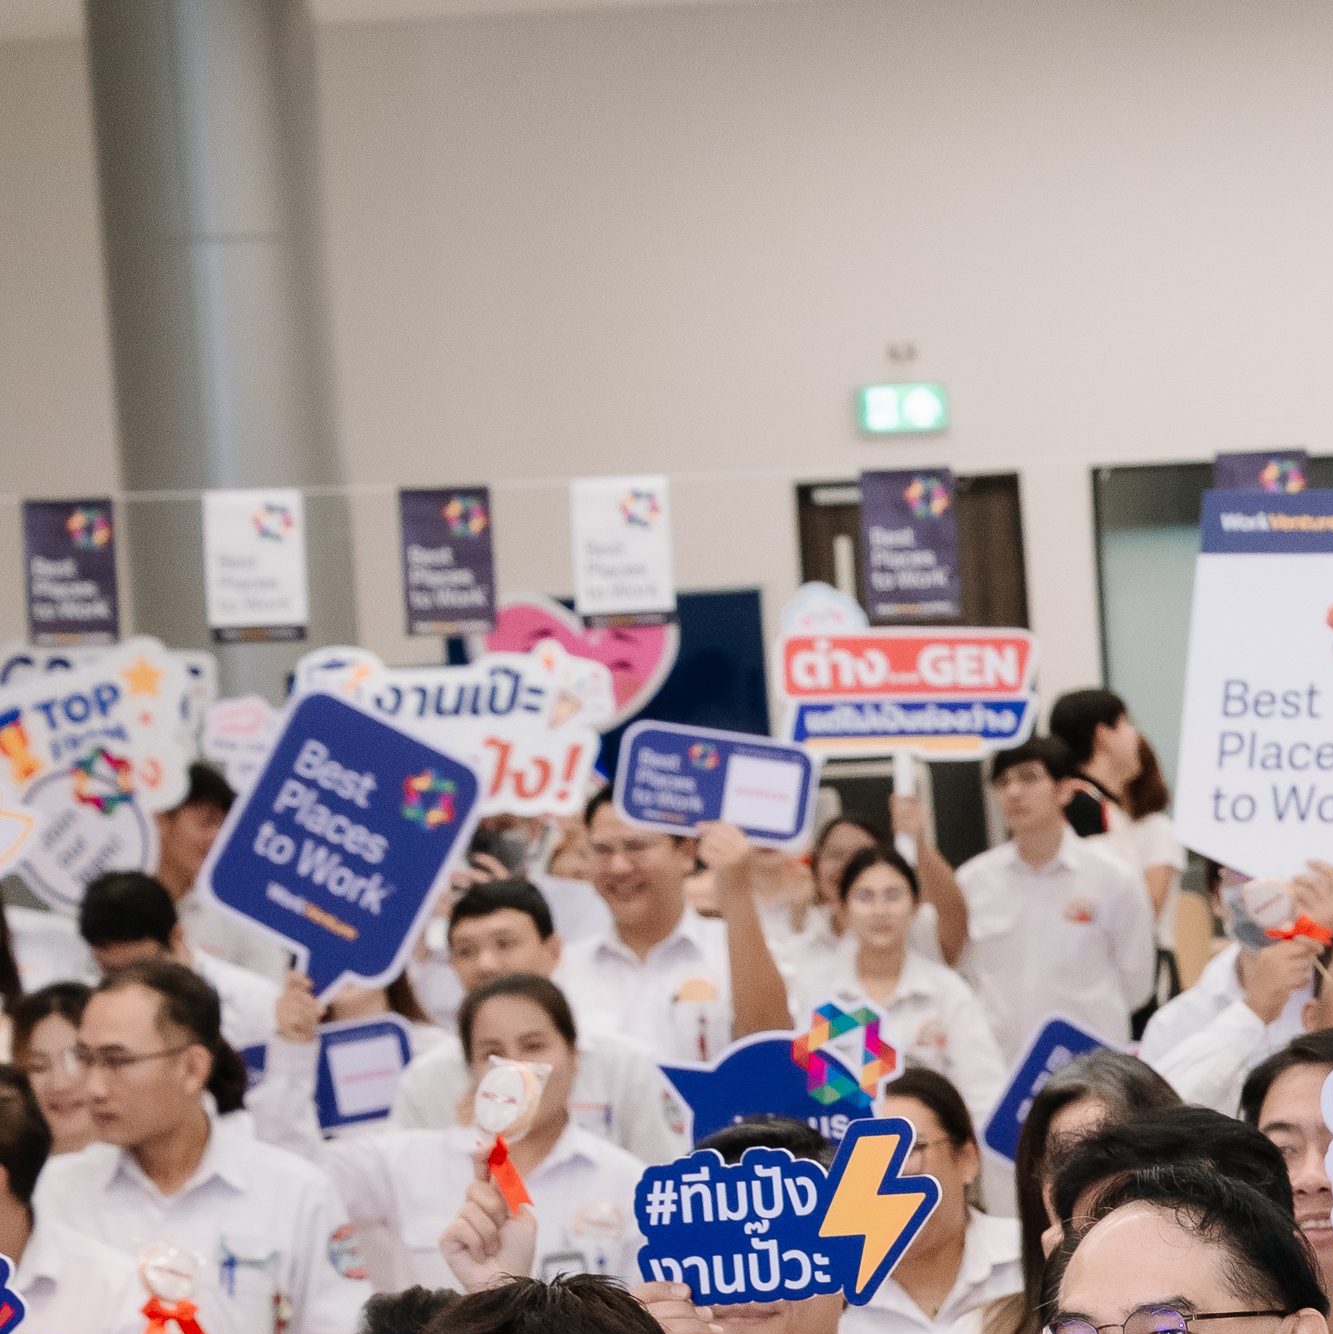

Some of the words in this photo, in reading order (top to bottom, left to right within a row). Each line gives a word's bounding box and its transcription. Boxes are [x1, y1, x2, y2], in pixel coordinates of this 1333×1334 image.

[33, 684, 121, 730] TOP
[1222, 678, 1322, 719] Best
[294, 738, 377, 809] Best
[272, 778, 390, 865] Places
[1211, 784, 1257, 824] to
[253, 821, 296, 865] to
[645, 1164, 818, 1227] #ทีมปัง
